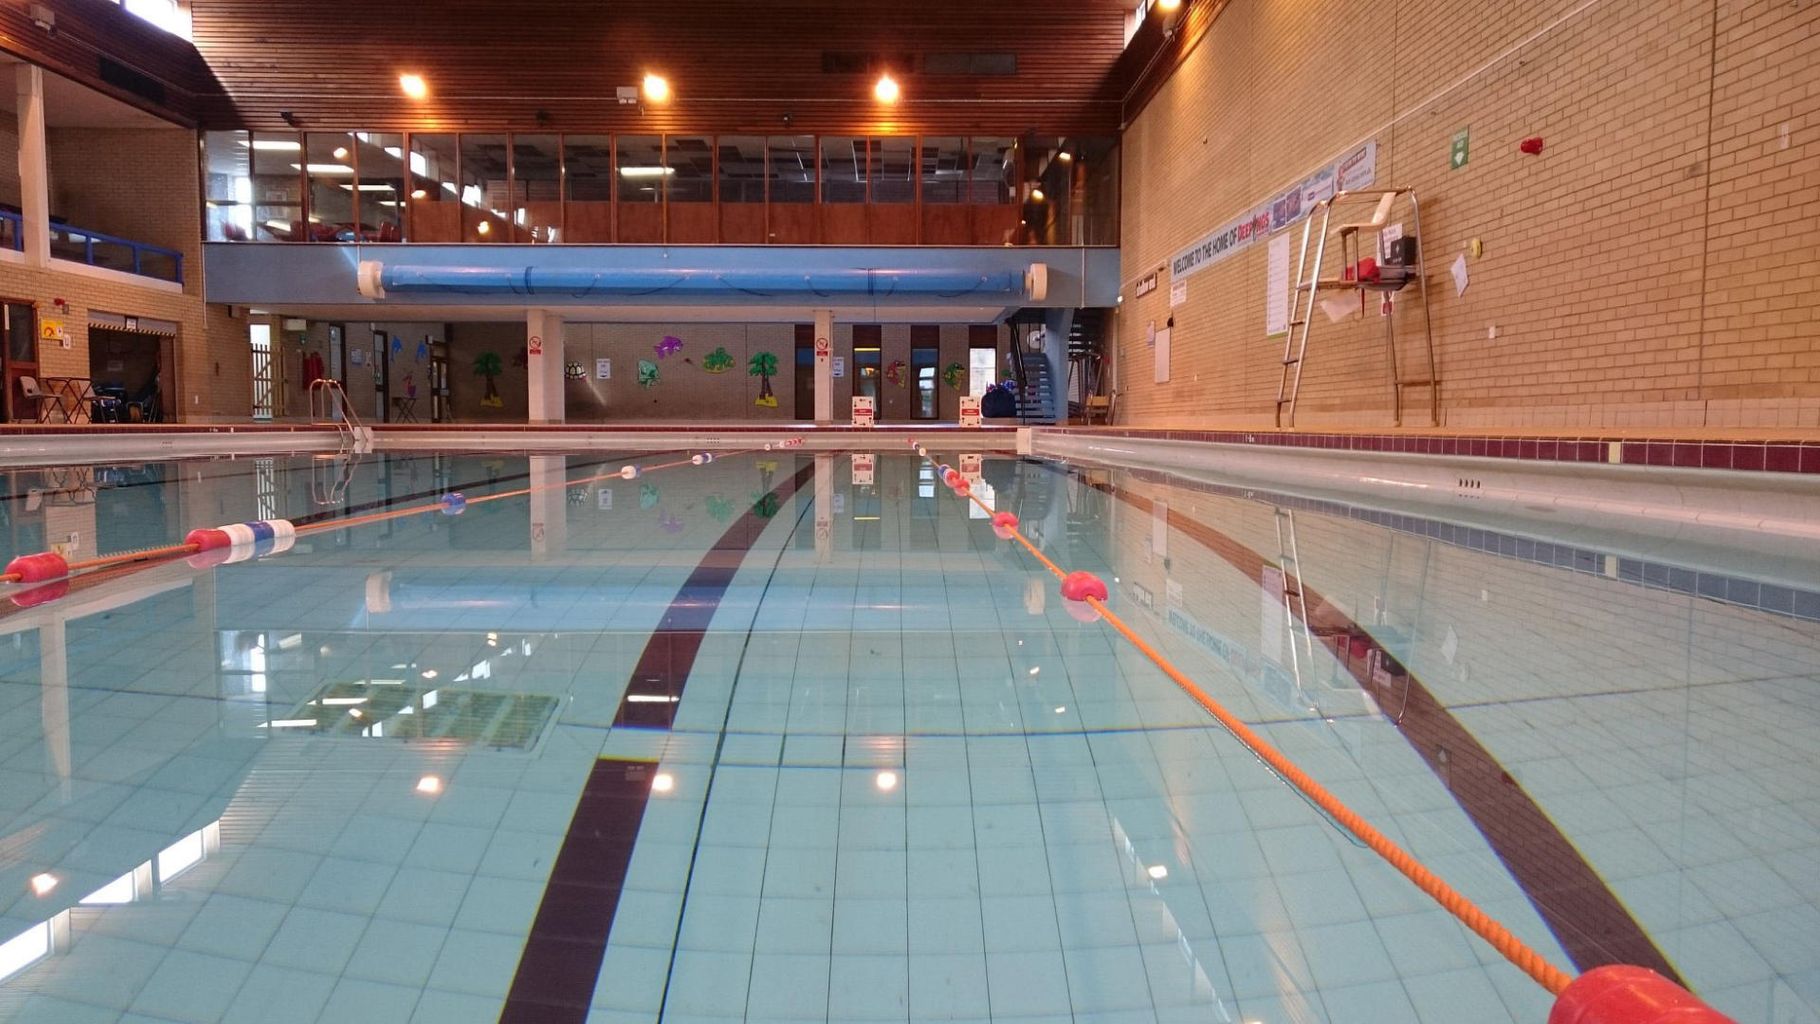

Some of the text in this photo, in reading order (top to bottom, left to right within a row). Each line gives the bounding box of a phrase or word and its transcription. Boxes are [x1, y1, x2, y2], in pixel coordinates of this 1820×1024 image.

[1173, 251, 1195, 275] WELCOME
[1195, 248, 1202, 265] TO
[1202, 241, 1212, 261] THE
[1212, 232, 1228, 255] HOME
[1229, 227, 1238, 247] OF
